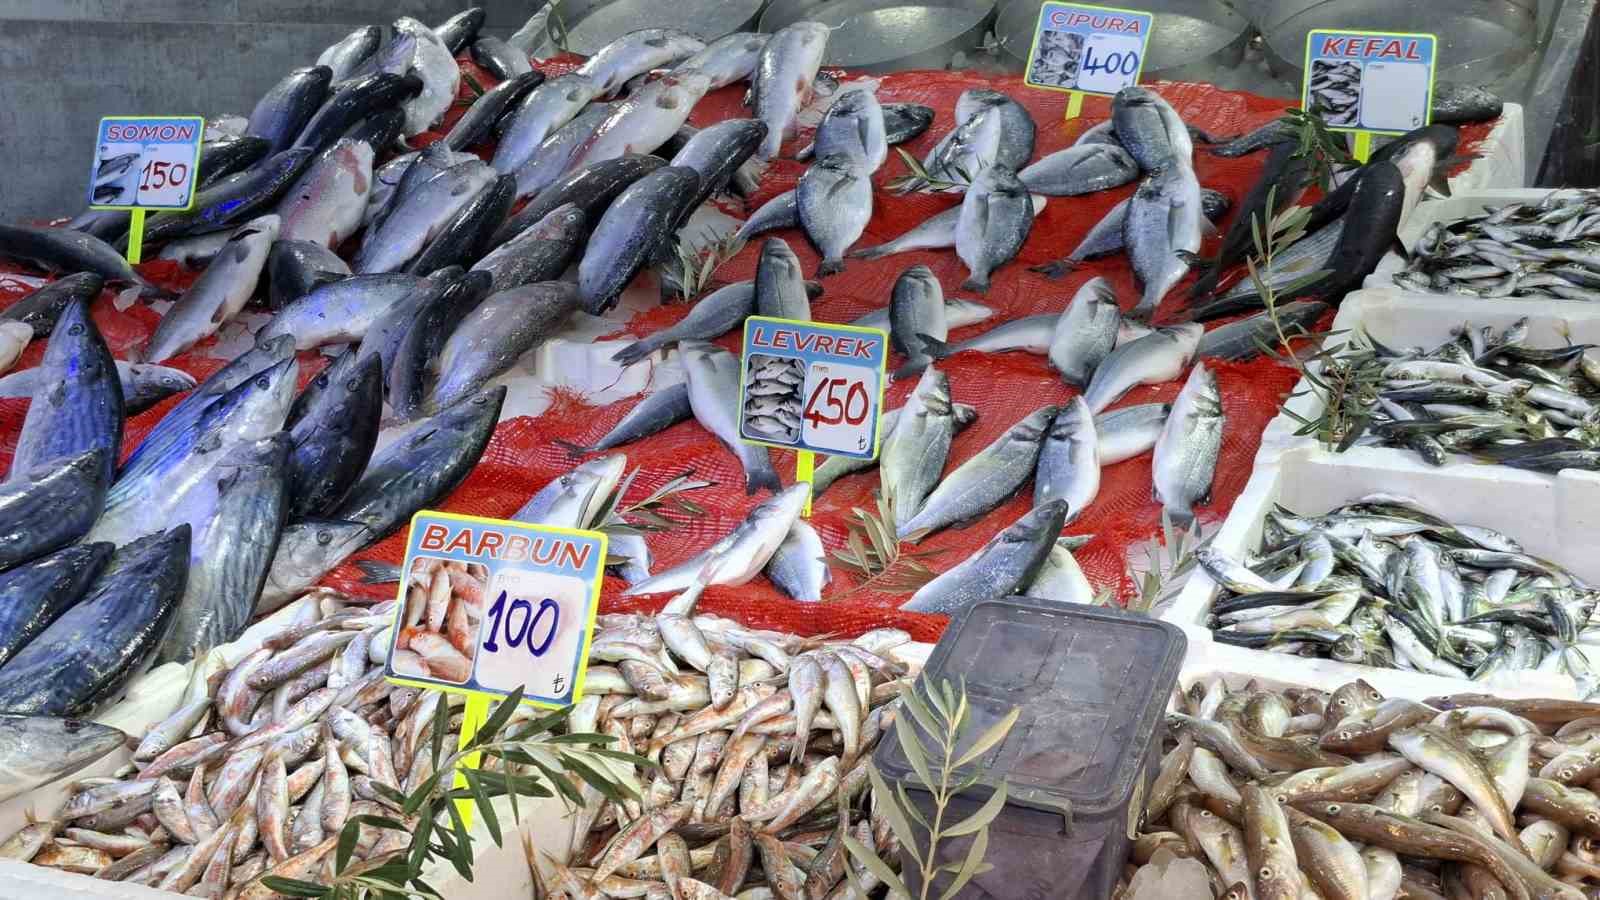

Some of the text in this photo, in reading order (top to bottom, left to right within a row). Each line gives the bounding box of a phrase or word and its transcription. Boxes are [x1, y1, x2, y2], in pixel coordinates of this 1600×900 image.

[1083, 46, 1139, 76] 400
[1322, 37, 1421, 60] KEFAL
[107, 125, 193, 141] SOMON
[140, 160, 187, 191] 150
[752, 327, 876, 359] LEVREK
[803, 377, 869, 429] 450
[420, 524, 592, 570] BARBUN
[483, 590, 560, 657] 100
